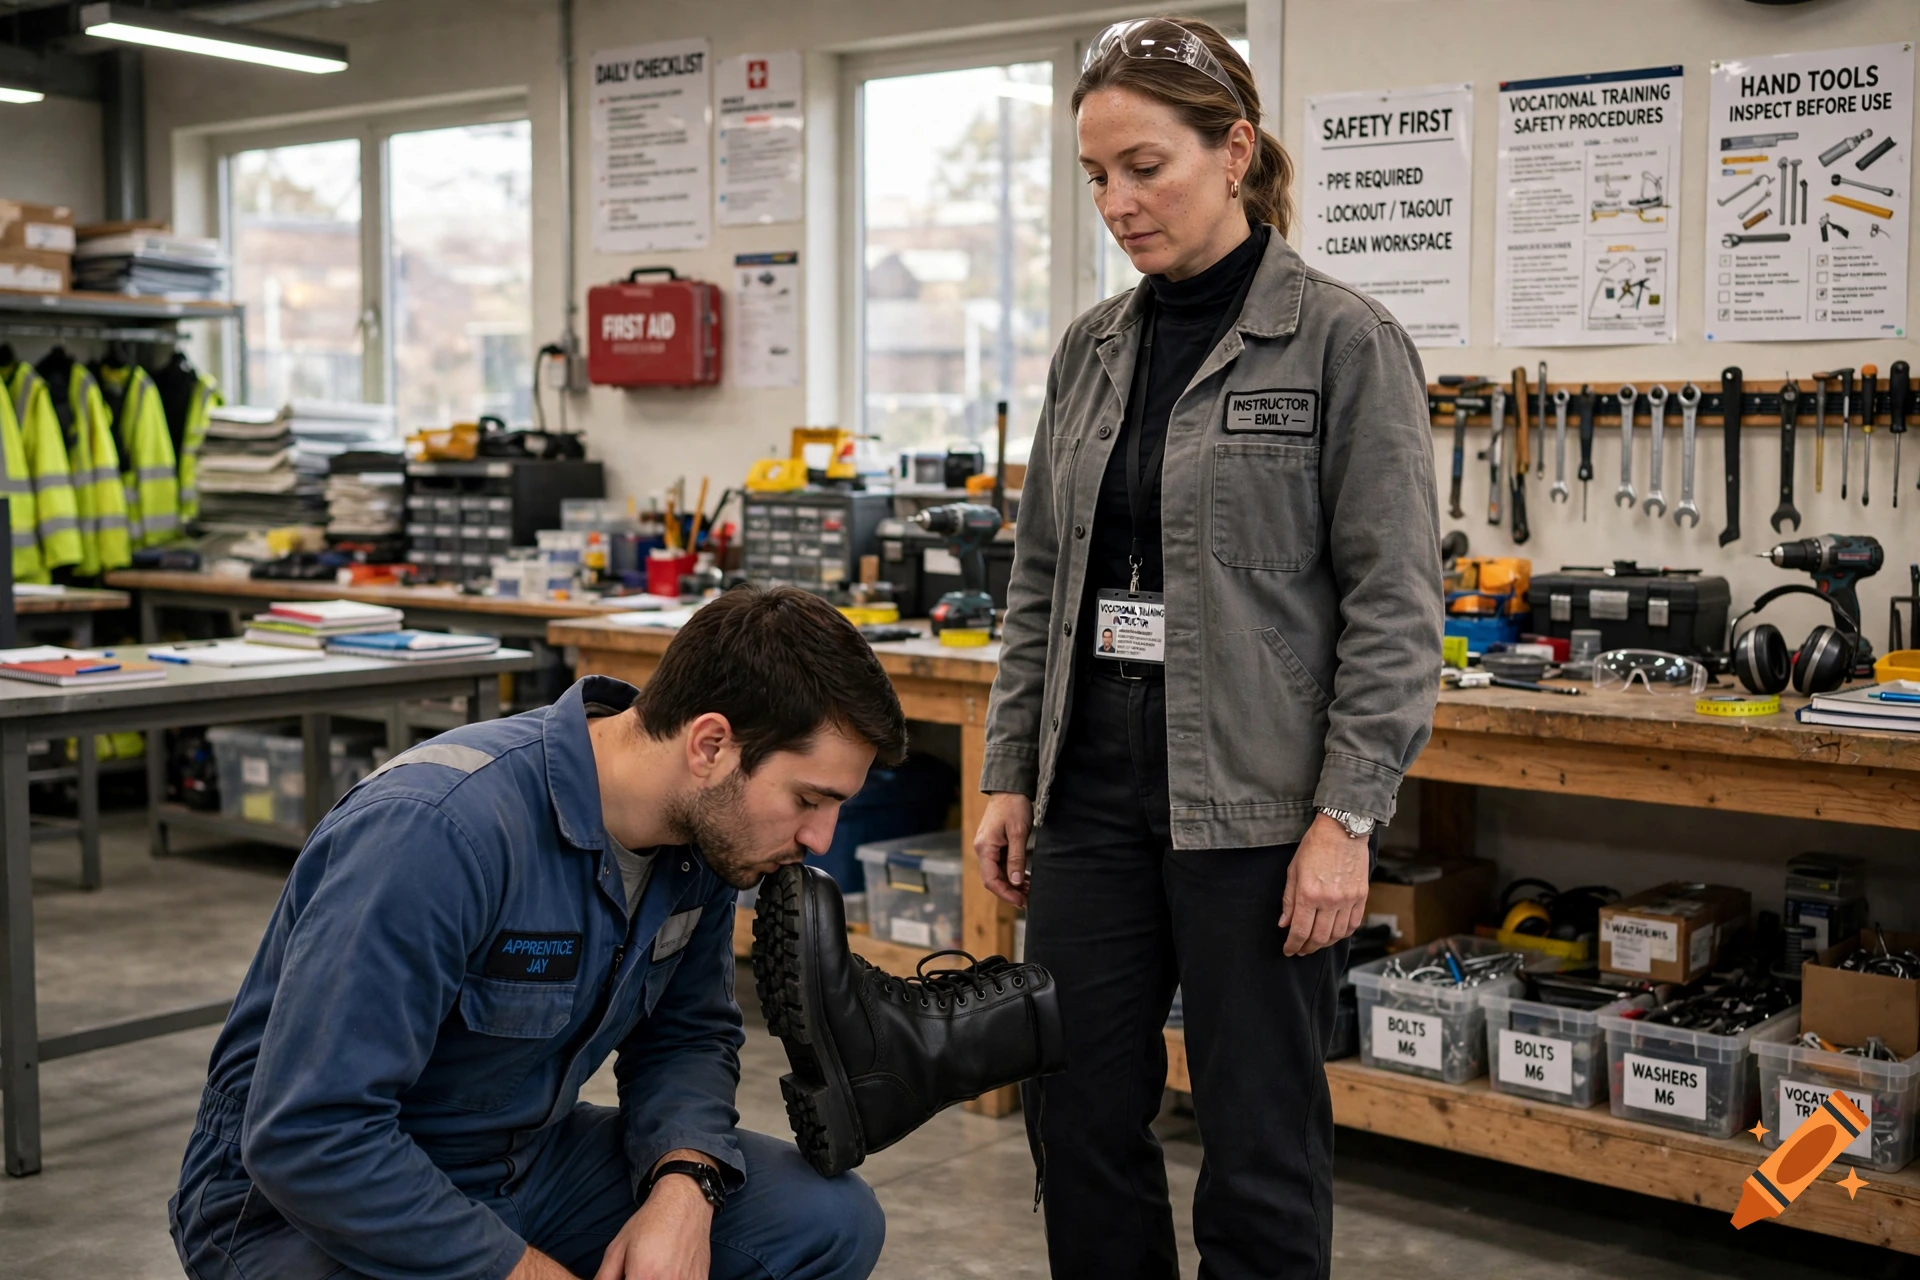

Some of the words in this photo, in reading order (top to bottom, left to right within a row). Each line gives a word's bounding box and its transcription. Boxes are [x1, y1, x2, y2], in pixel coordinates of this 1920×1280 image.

[596, 61, 631, 85] DAILY
[633, 52, 705, 80] CHECKLIST
[1741, 73, 1800, 98] HAND
[1808, 65, 1879, 91] TOOLS
[1509, 89, 1597, 113] VOCATIONAL
[1601, 84, 1671, 104] TRAINING
[1729, 101, 1792, 122] INSPECT
[1796, 96, 1857, 117] BEFORE
[1861, 92, 1893, 110] USE
[1323, 113, 1393, 141] SAFETY
[1399, 109, 1453, 135] FIRST
[1514, 113, 1567, 134] SAFETY
[1569, 107, 1663, 131] PROCEDURES
[1327, 172, 1351, 190] PPE
[1355, 168, 1423, 189] REQUIRED
[1327, 203, 1386, 223] LOCKOUT
[1389, 201, 1396, 220] /
[1400, 198, 1453, 219] TAGOUT
[1326, 236, 1367, 255] CLEAN
[1370, 232, 1453, 253] WORKSPACE
[602, 313, 646, 340] FIRST
[647, 312, 676, 340] AID
[1233, 397, 1309, 411] INSTRUCTOR
[1255, 413, 1289, 426] EMILY
[503, 938, 574, 955] APPRENTICE
[526, 958, 549, 973] JAY
[1388, 1016, 1426, 1037] BOLTS
[1398, 1040, 1417, 1057] M6
[1515, 1040, 1554, 1061] BOLTS
[1525, 1064, 1544, 1081] M6
[1632, 1062, 1698, 1088] WASHERS
[1655, 1088, 1675, 1106] M6
